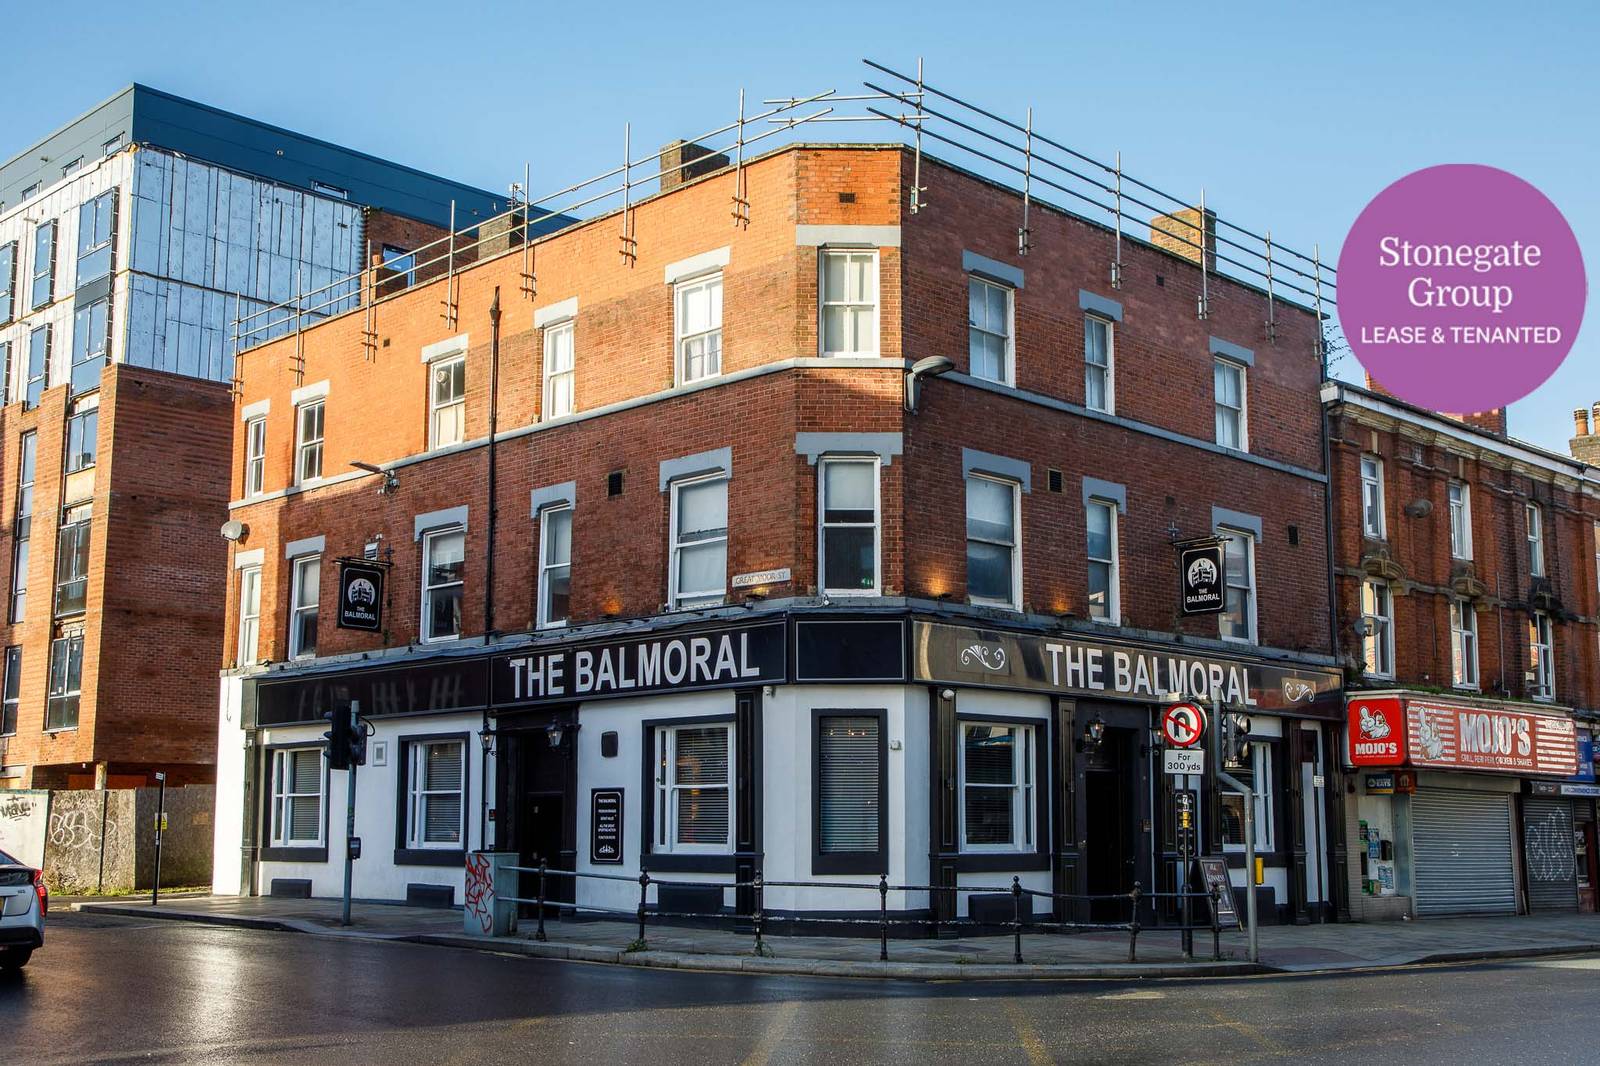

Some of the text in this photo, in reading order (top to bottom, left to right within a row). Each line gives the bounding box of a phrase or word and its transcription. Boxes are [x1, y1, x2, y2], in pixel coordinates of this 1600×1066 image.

[1186, 593, 1220, 603] BALMORAL
[344, 610, 375, 620] BALMORAL
[510, 632, 760, 699] THE BALMORAL
[1045, 643, 1257, 706] THE BALMORAL
[1458, 712, 1531, 757] MOJO'S
[1355, 742, 1398, 755] MOJO'S
[1177, 753, 1191, 761] For
[1167, 762, 1201, 772] 300 yds
